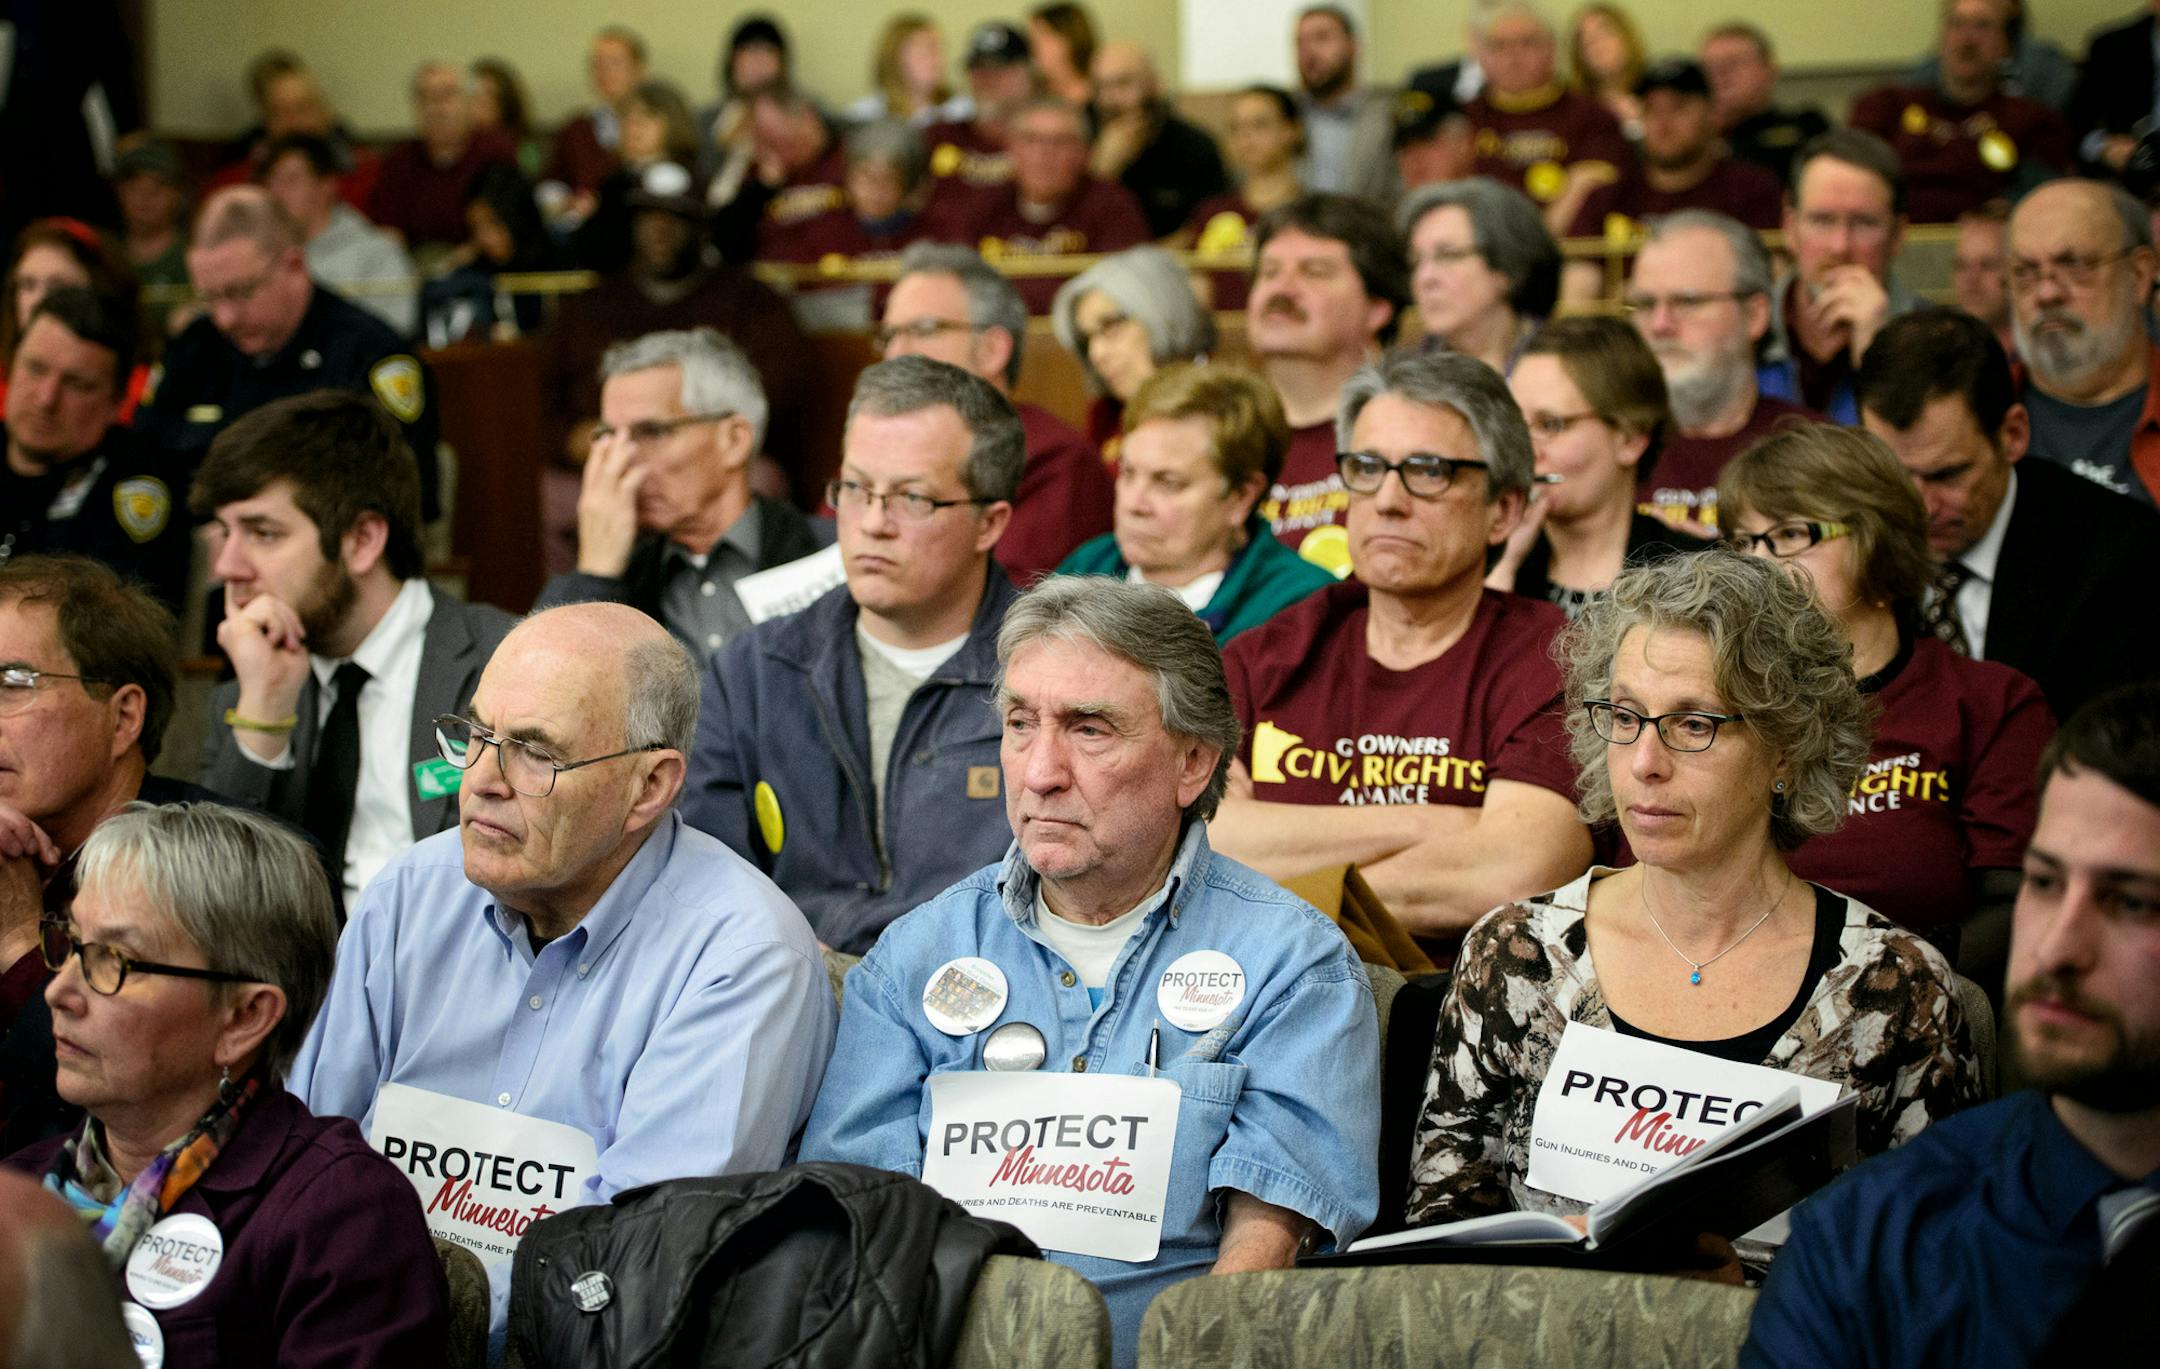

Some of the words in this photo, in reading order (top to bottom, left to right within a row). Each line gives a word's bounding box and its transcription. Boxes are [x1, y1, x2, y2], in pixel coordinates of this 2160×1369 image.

[1357, 734, 1450, 756] OWNERS
[1363, 755, 1485, 792] RIGHTS
[1162, 972, 1242, 988] PROTECT
[1561, 1069, 1765, 1127] PROTEC
[943, 1114, 1149, 1157] PROTECT
[384, 1135, 576, 1199] PROTECT
[988, 1145, 1135, 1196] Minnesota
[427, 1176, 557, 1238] Minnesot
[1076, 1204, 1158, 1223] PREVENTABLE
[138, 1233, 220, 1267] PROTECT
